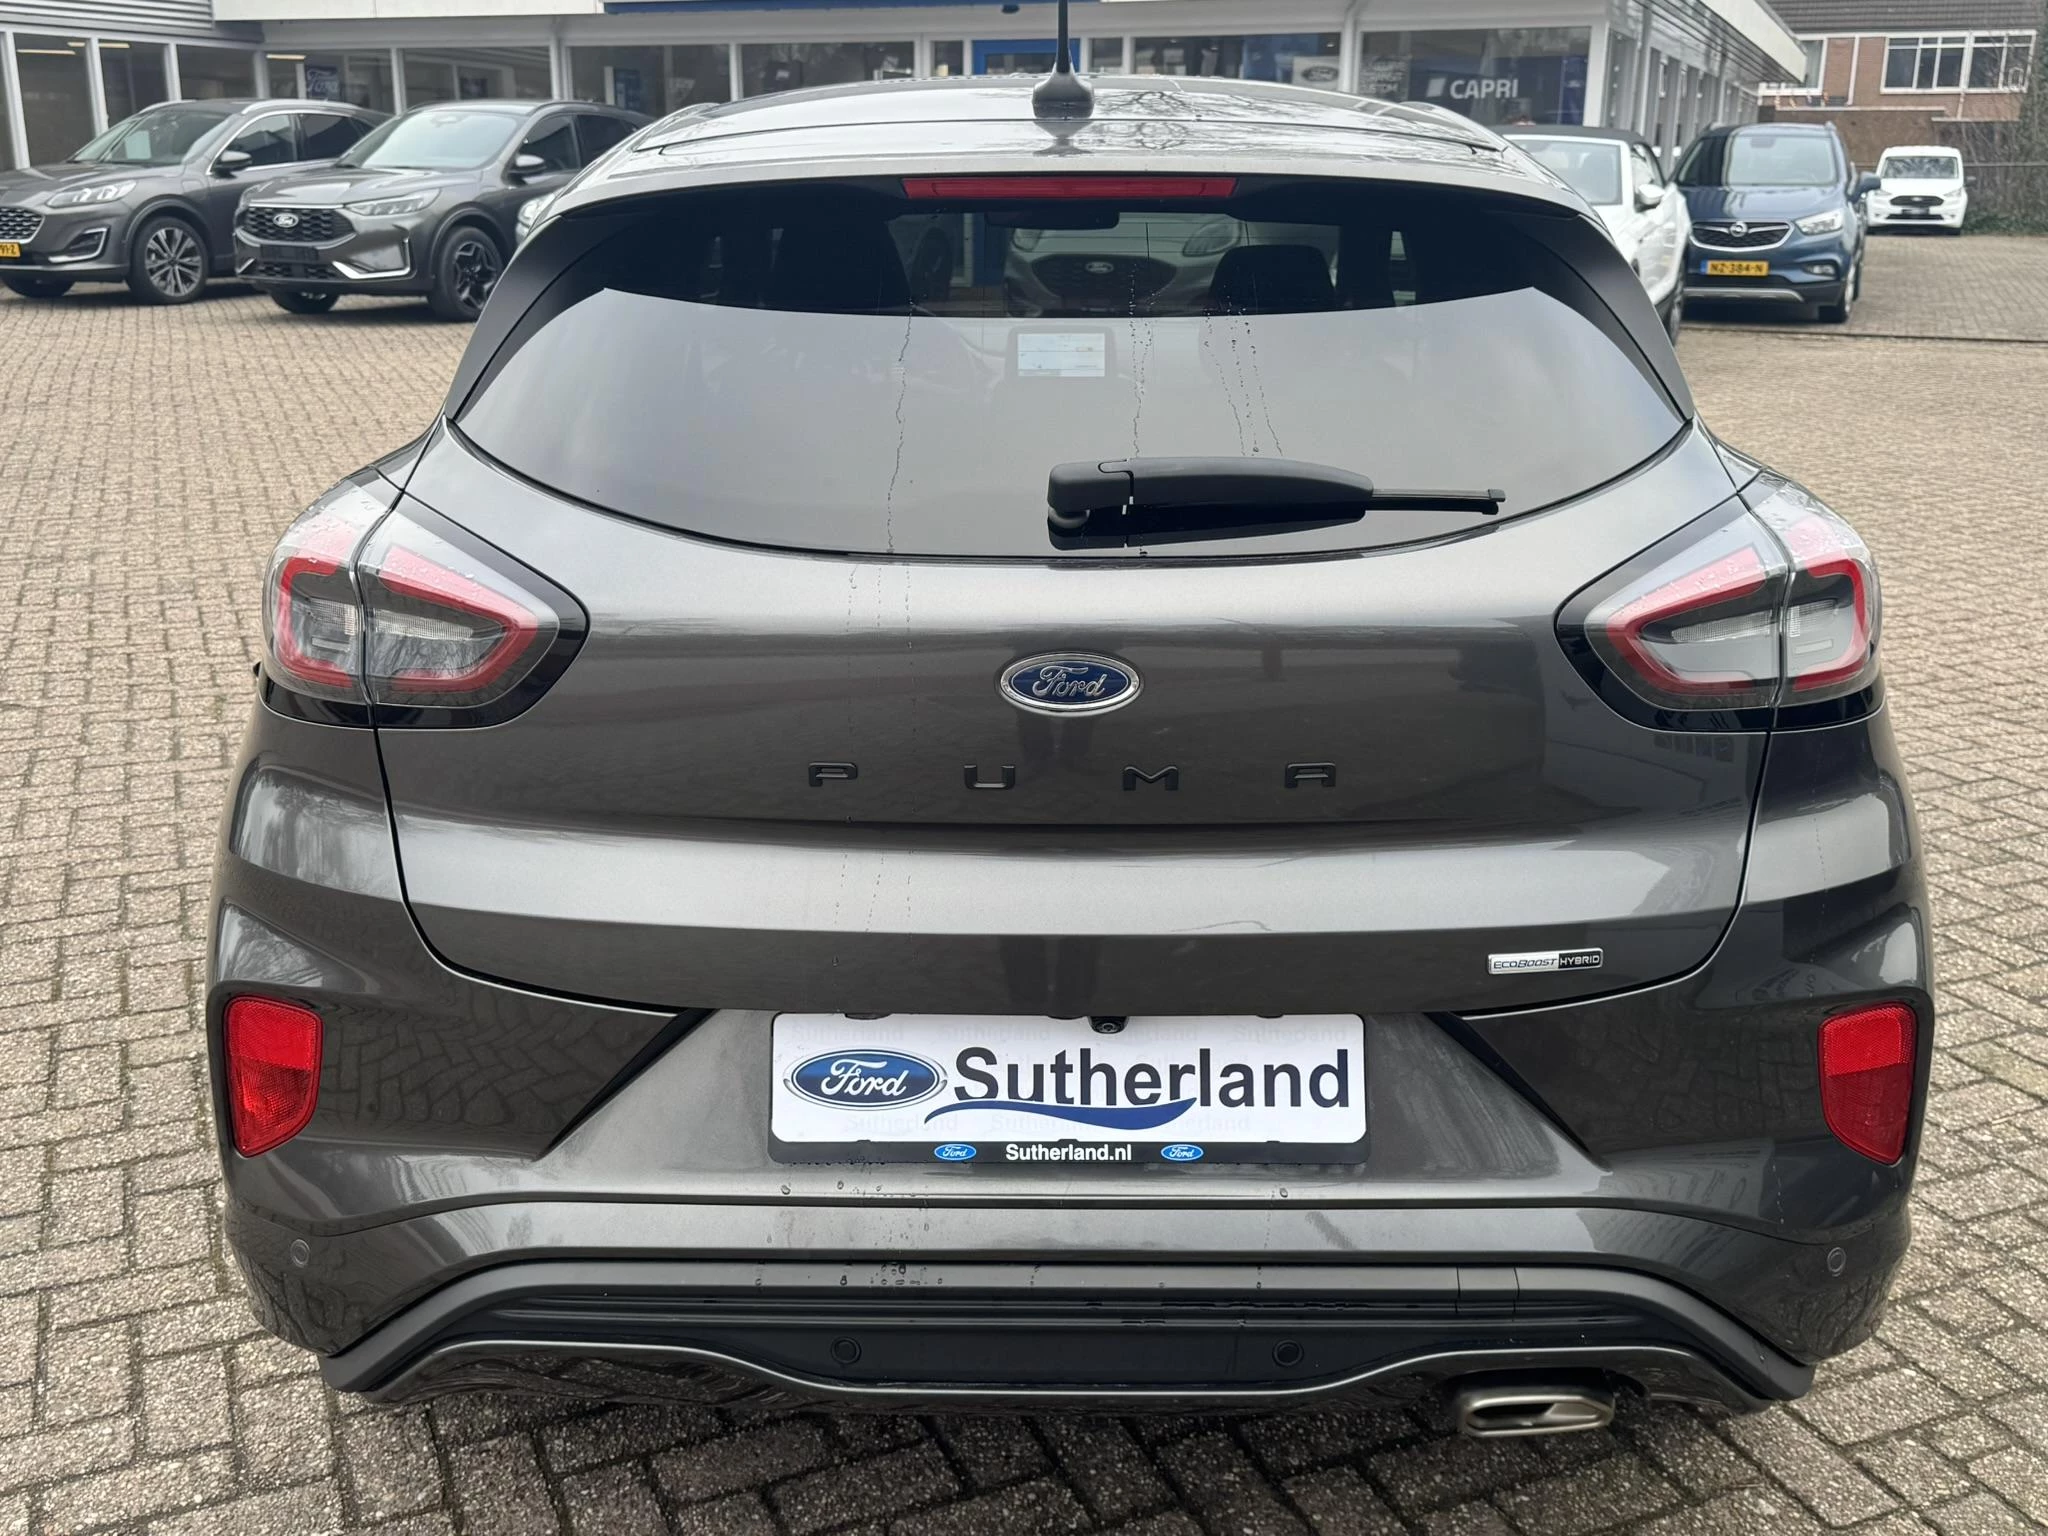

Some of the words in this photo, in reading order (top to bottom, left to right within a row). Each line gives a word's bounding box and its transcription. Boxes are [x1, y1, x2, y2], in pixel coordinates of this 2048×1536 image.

[1450, 79, 1518, 99] CAPRI
[1710, 263, 1764, 273] NZ-384-N
[1032, 665, 1107, 697] Ford
[808, 761, 1337, 791] PUMA
[1560, 955, 1600, 966] HYBRID
[820, 1058, 907, 1097] Ford
[953, 1046, 1350, 1109] Sutherland
[1005, 1143, 1132, 1161] Sutherland.nl
